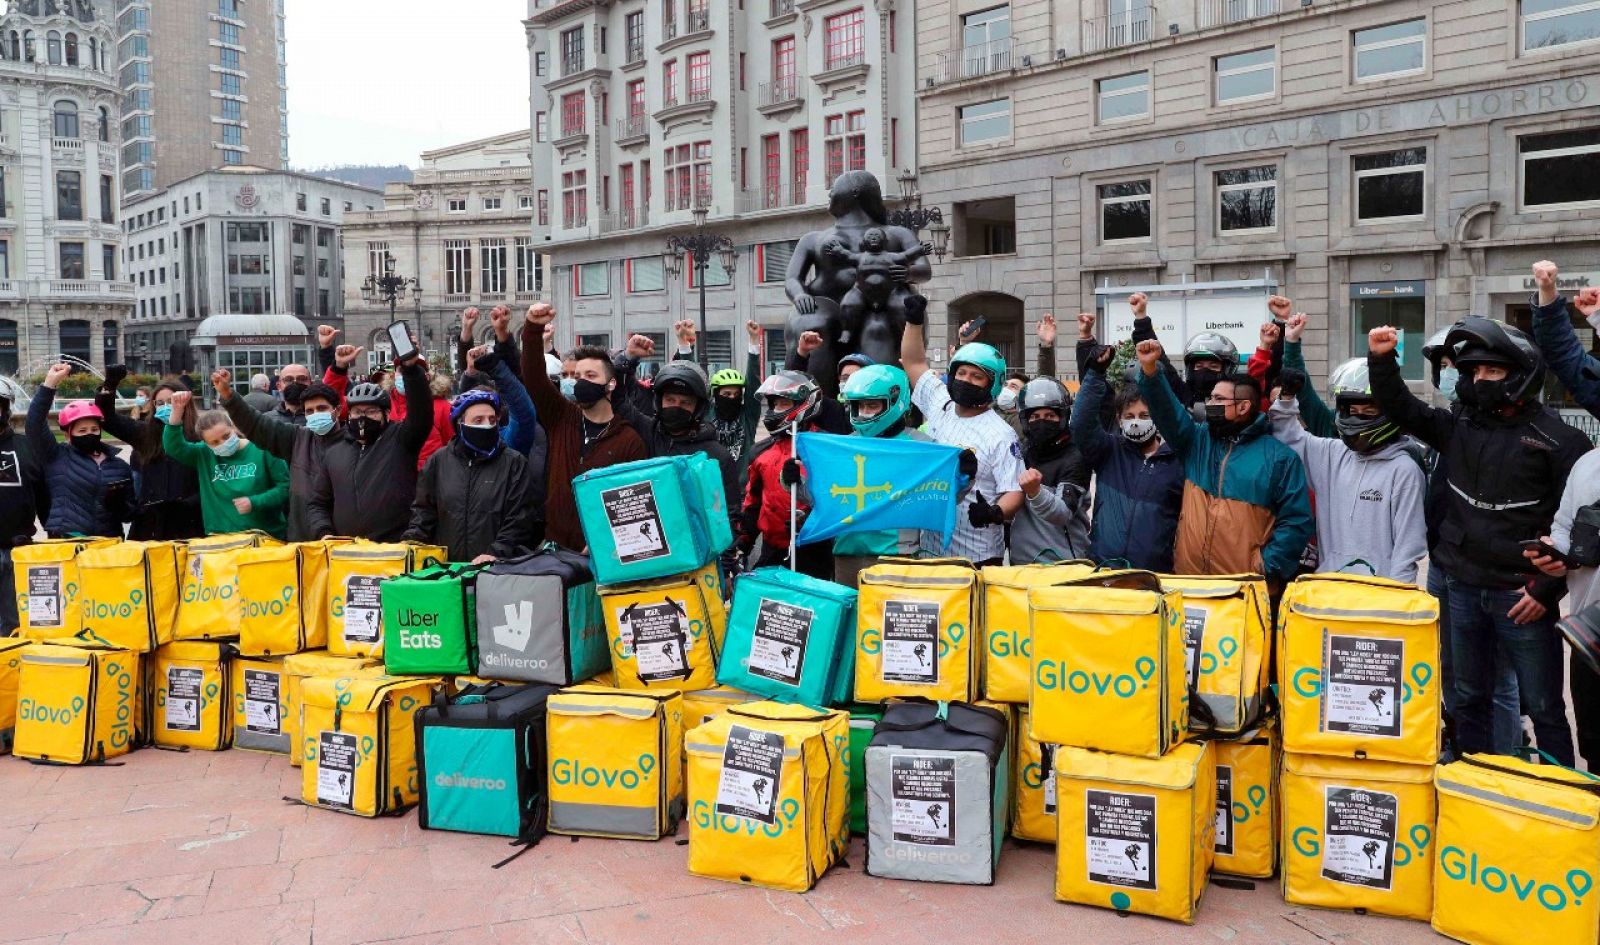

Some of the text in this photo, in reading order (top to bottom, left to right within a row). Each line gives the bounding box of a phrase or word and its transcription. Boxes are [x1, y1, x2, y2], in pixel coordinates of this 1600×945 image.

[1243, 80, 1588, 147] CAJA DE AHORRO
[1205, 321, 1245, 330] Liberbank
[183, 583, 233, 603] Glovo
[83, 599, 131, 618] Glovo
[398, 609, 439, 627] Uber
[400, 631, 442, 649] Eats
[485, 652, 548, 670] deliveroo
[1036, 659, 1136, 698] Glovo
[19, 698, 71, 725] Glovo
[435, 771, 506, 790] deliveroo
[552, 759, 640, 789] Glovo
[884, 844, 973, 864] deliveroo
[1440, 846, 1567, 911] Glovo
